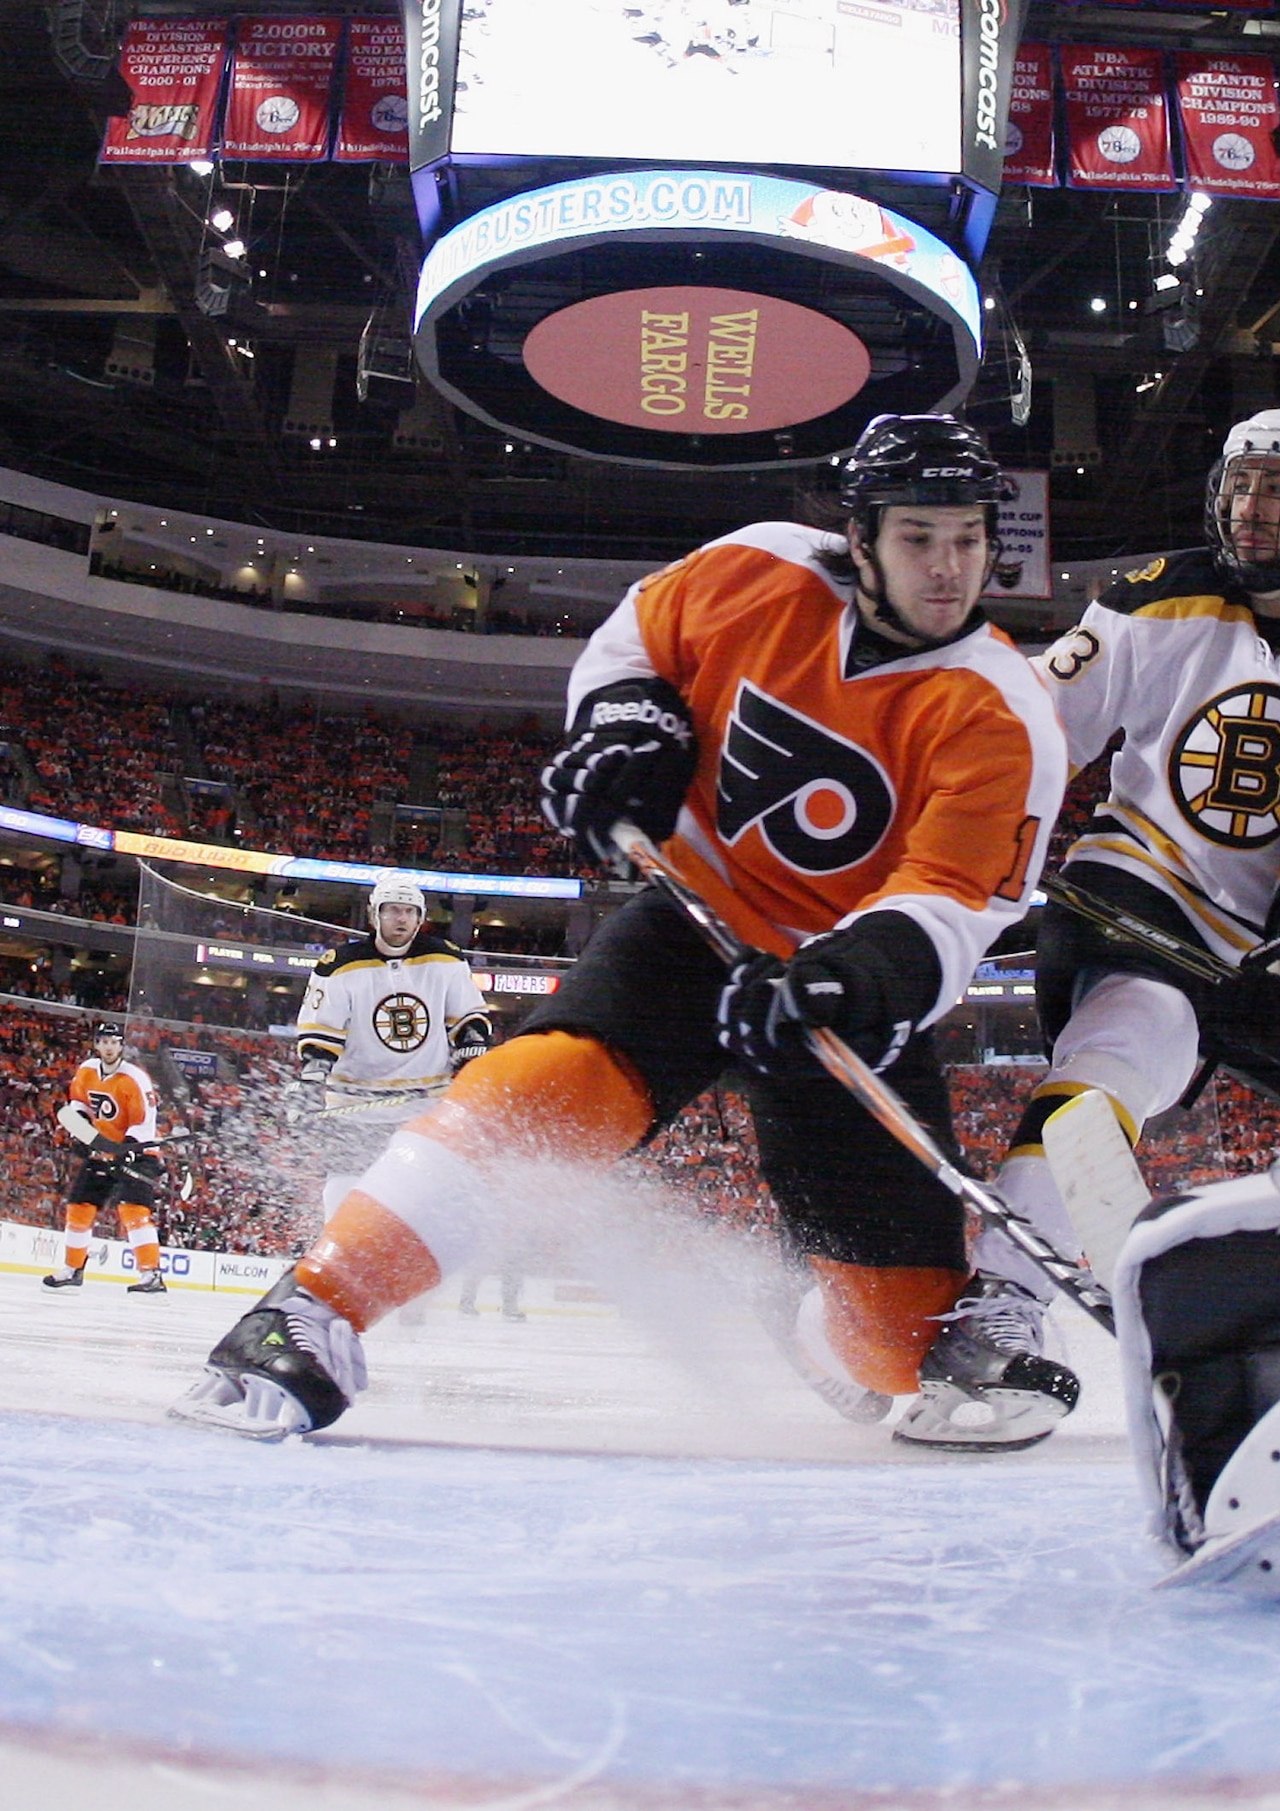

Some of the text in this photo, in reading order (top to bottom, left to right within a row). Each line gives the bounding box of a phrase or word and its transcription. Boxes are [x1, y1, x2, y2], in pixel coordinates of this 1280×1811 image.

[128, 21, 227, 31] NBA ATLANTIC
[351, 24, 380, 33] NBA
[146, 32, 207, 42] DIVISION
[126, 42, 222, 53] AND EASTERN
[240, 42, 336, 57] VICTORY
[351, 45, 383, 55] AND
[127, 54, 217, 64] CONFERENCE
[1093, 52, 1129, 64] NBA
[129, 64, 211, 74] CHAMPIONS
[1072, 64, 1153, 78] ATLANTIC
[1207, 60, 1241, 72] NBA
[139, 76, 173, 86] 2000
[182, 76, 197, 86] 01
[1077, 78, 1150, 91] DIVISION
[1185, 72, 1266, 87] ATLANTIC
[1065, 91, 1163, 107] CHAMPIONS
[1190, 84, 1263, 100] DIVISION
[1085, 105, 1149, 119] 1977-78
[1181, 96, 1277, 114] CHAMPIONS
[1200, 112, 1261, 127] 1989-90
[106, 146, 176, 157] Philadelphia
[225, 141, 292, 152] Philadelphia
[1072, 168, 1141, 182] Philadelphia
[1189, 175, 1255, 189] Philadelphia
[640, 309, 690, 416] FARGO
[702, 308, 760, 420] WELLS
[921, 466, 974, 479] CCM
[1019, 512, 1043, 521] CUP
[1046, 625, 1103, 684] 3
[589, 699, 693, 749] Reebok
[142, 843, 252, 868] BUD LIGHT
[323, 864, 370, 881] BUD
[450, 878, 497, 892] HERE
[498, 880, 525, 893] WE
[208, 946, 244, 960] PLAYER
[496, 975, 547, 992] FLYERS
[967, 985, 1004, 996] PLAYER
[219, 1262, 270, 1279] NHL.COM
